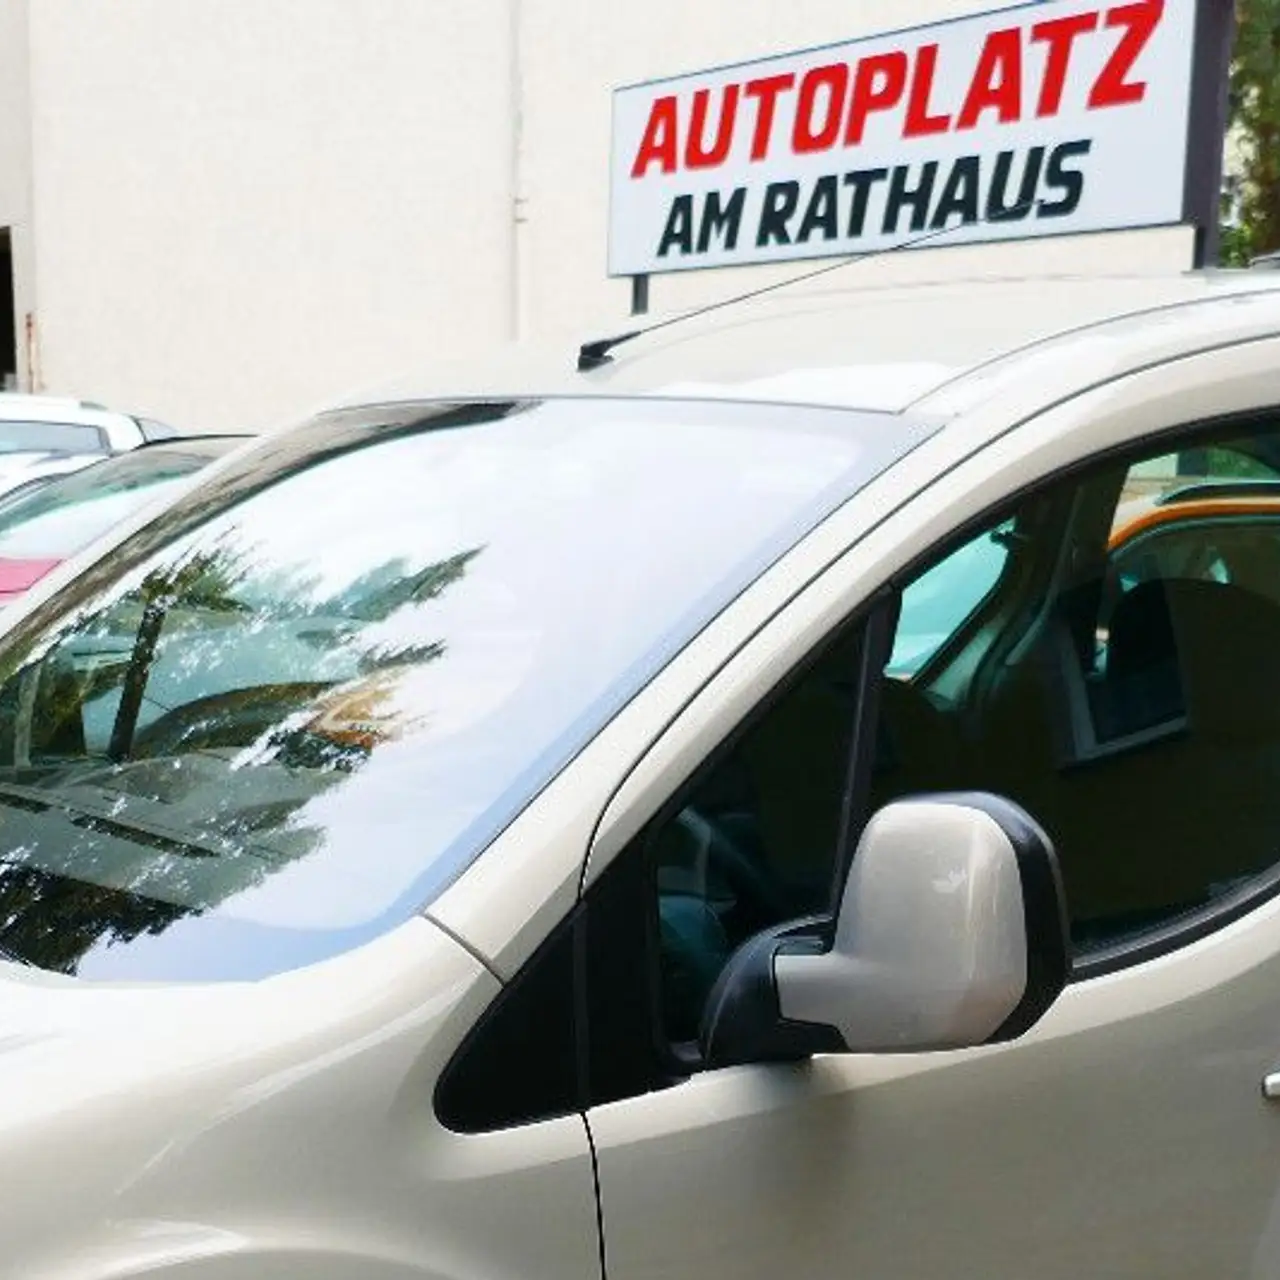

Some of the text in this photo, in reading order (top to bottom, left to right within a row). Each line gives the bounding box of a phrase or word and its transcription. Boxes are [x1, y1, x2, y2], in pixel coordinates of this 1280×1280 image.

[631, 0, 1165, 178] AUTOPLATZ
[657, 140, 1092, 257] AM RATHAUS
